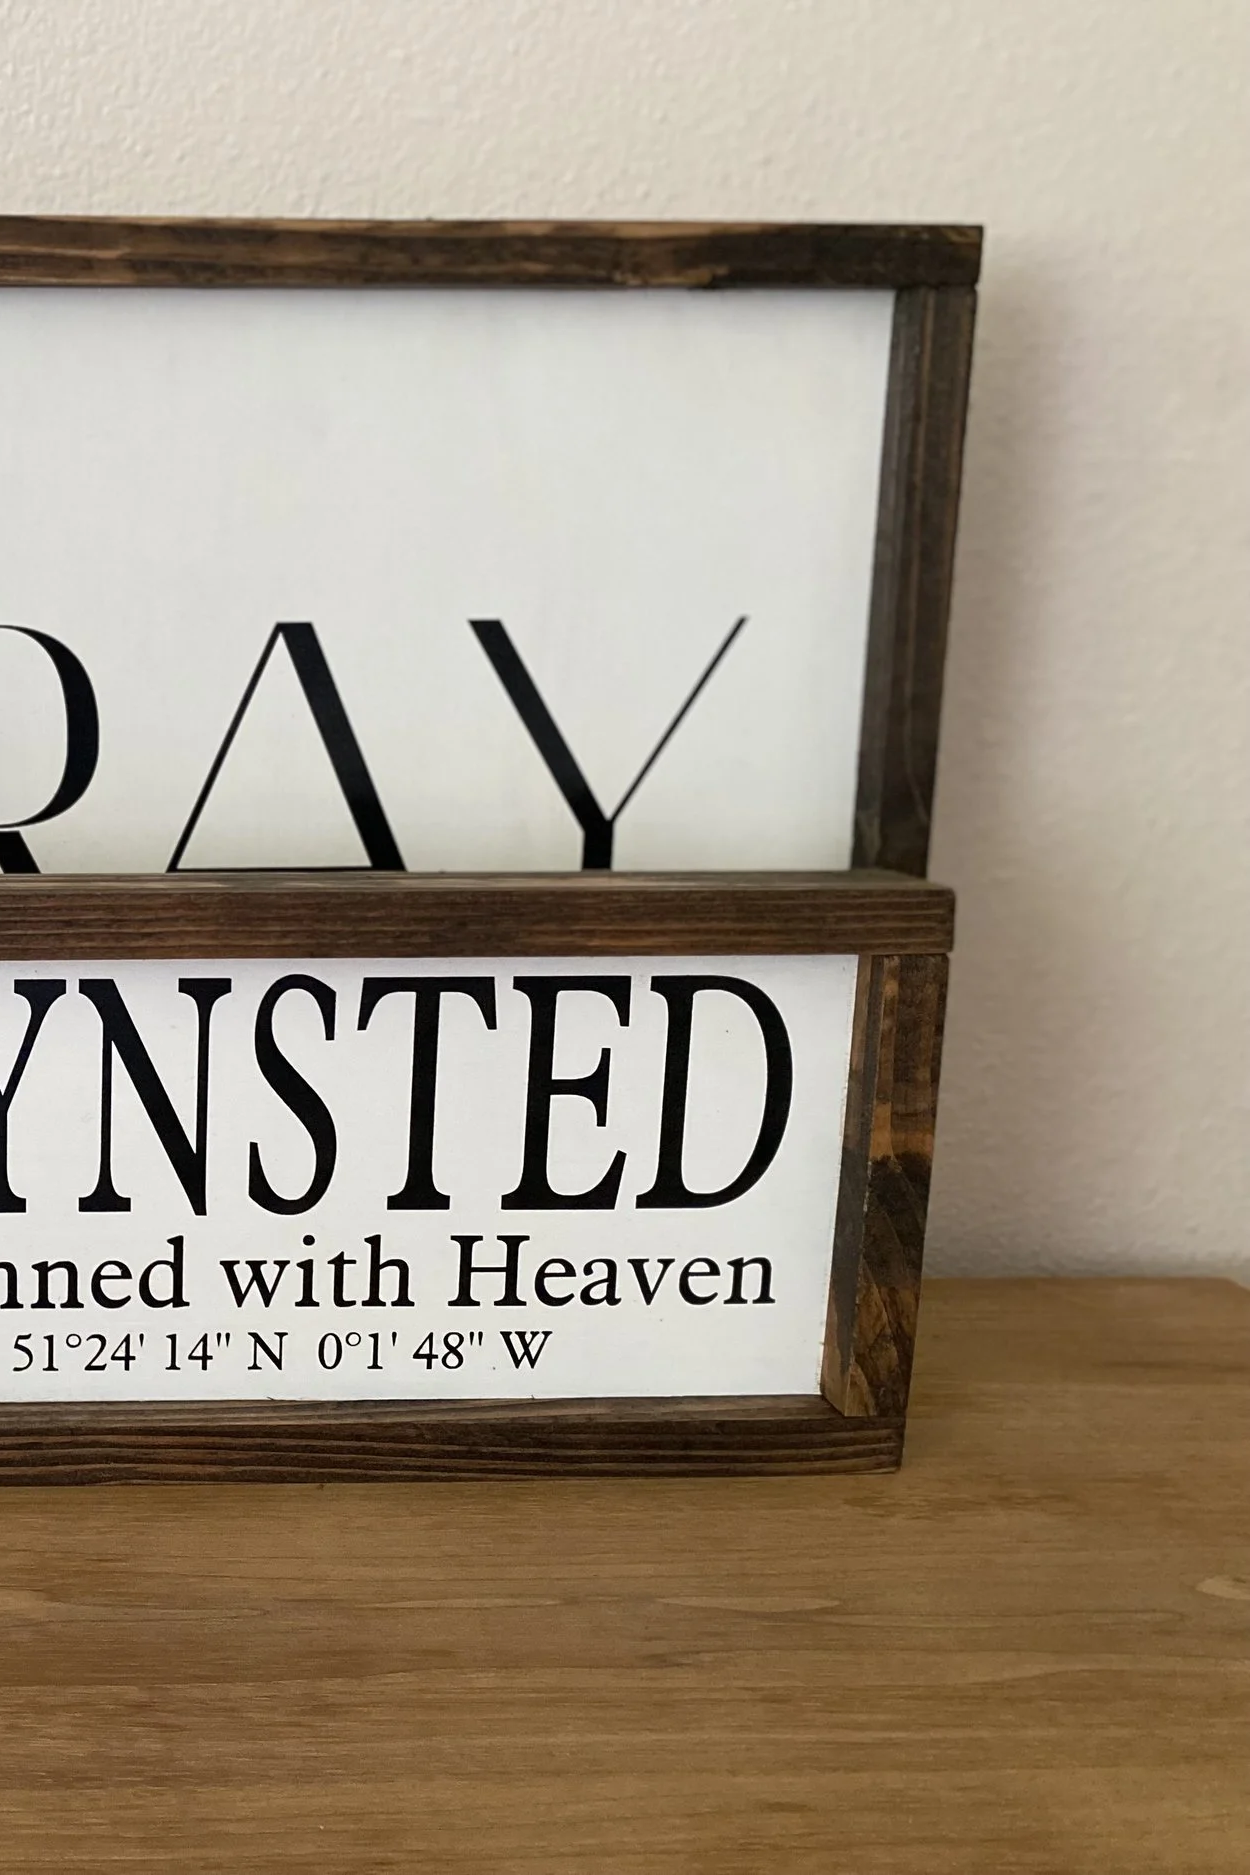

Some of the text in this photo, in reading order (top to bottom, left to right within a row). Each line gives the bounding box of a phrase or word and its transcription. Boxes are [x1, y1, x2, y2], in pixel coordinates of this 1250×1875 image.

[219, 1234, 415, 1308] with
[447, 1234, 776, 1307] Heaven
[12, 1330, 553, 1372] 51°24' 14" N 0°1' 48" W
